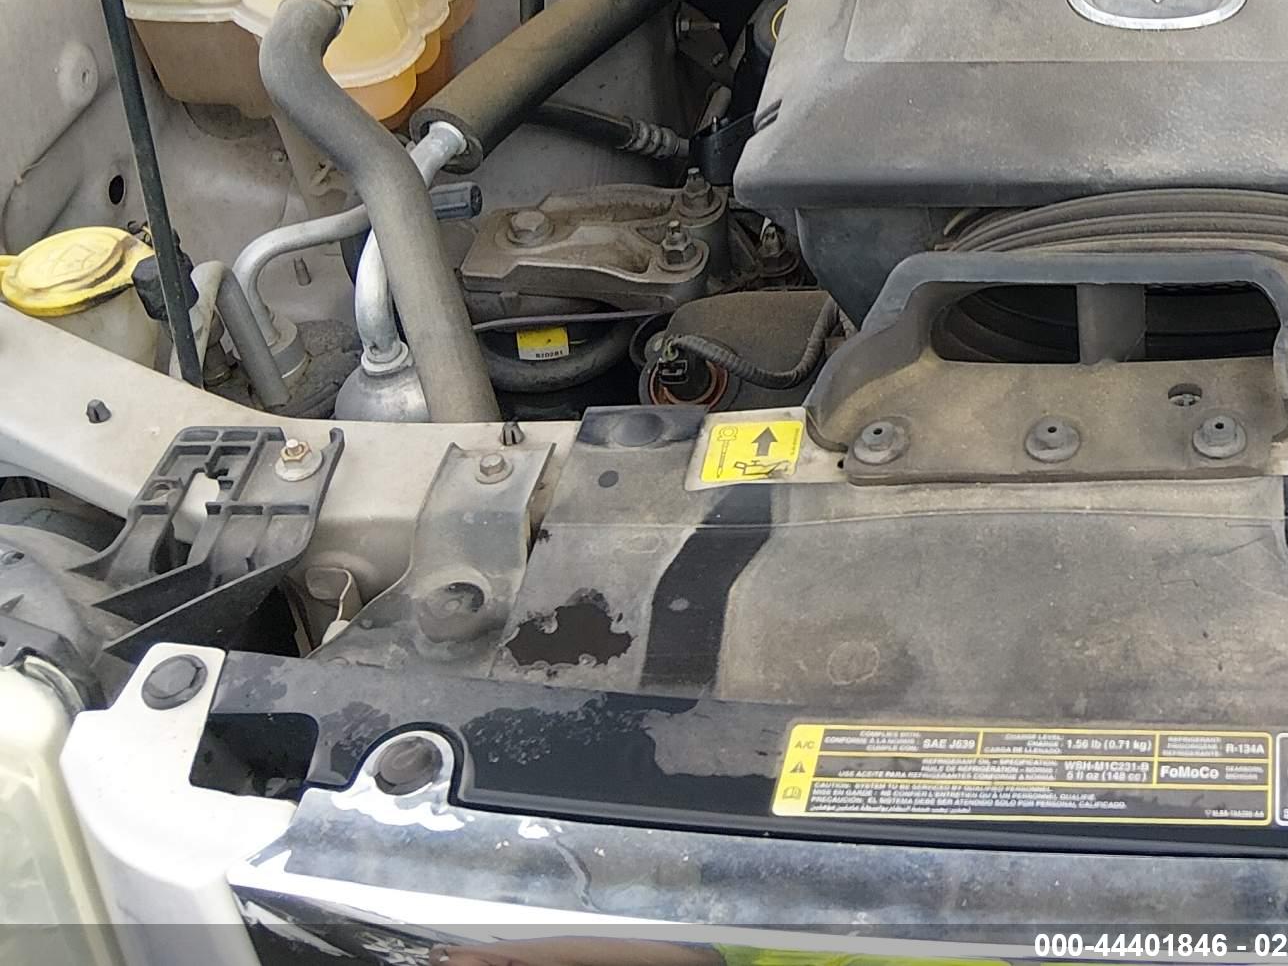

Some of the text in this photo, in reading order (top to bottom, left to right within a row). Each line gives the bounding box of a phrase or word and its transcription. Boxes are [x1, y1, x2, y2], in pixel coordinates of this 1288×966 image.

[794, 740, 815, 749] A/C
[922, 738, 976, 750] SAE J639
[1066, 738, 1152, 752] 1.56 lb (0.71 kg)
[1225, 743, 1264, 754] R-134A
[1160, 765, 1219, 779] FoMoCo
